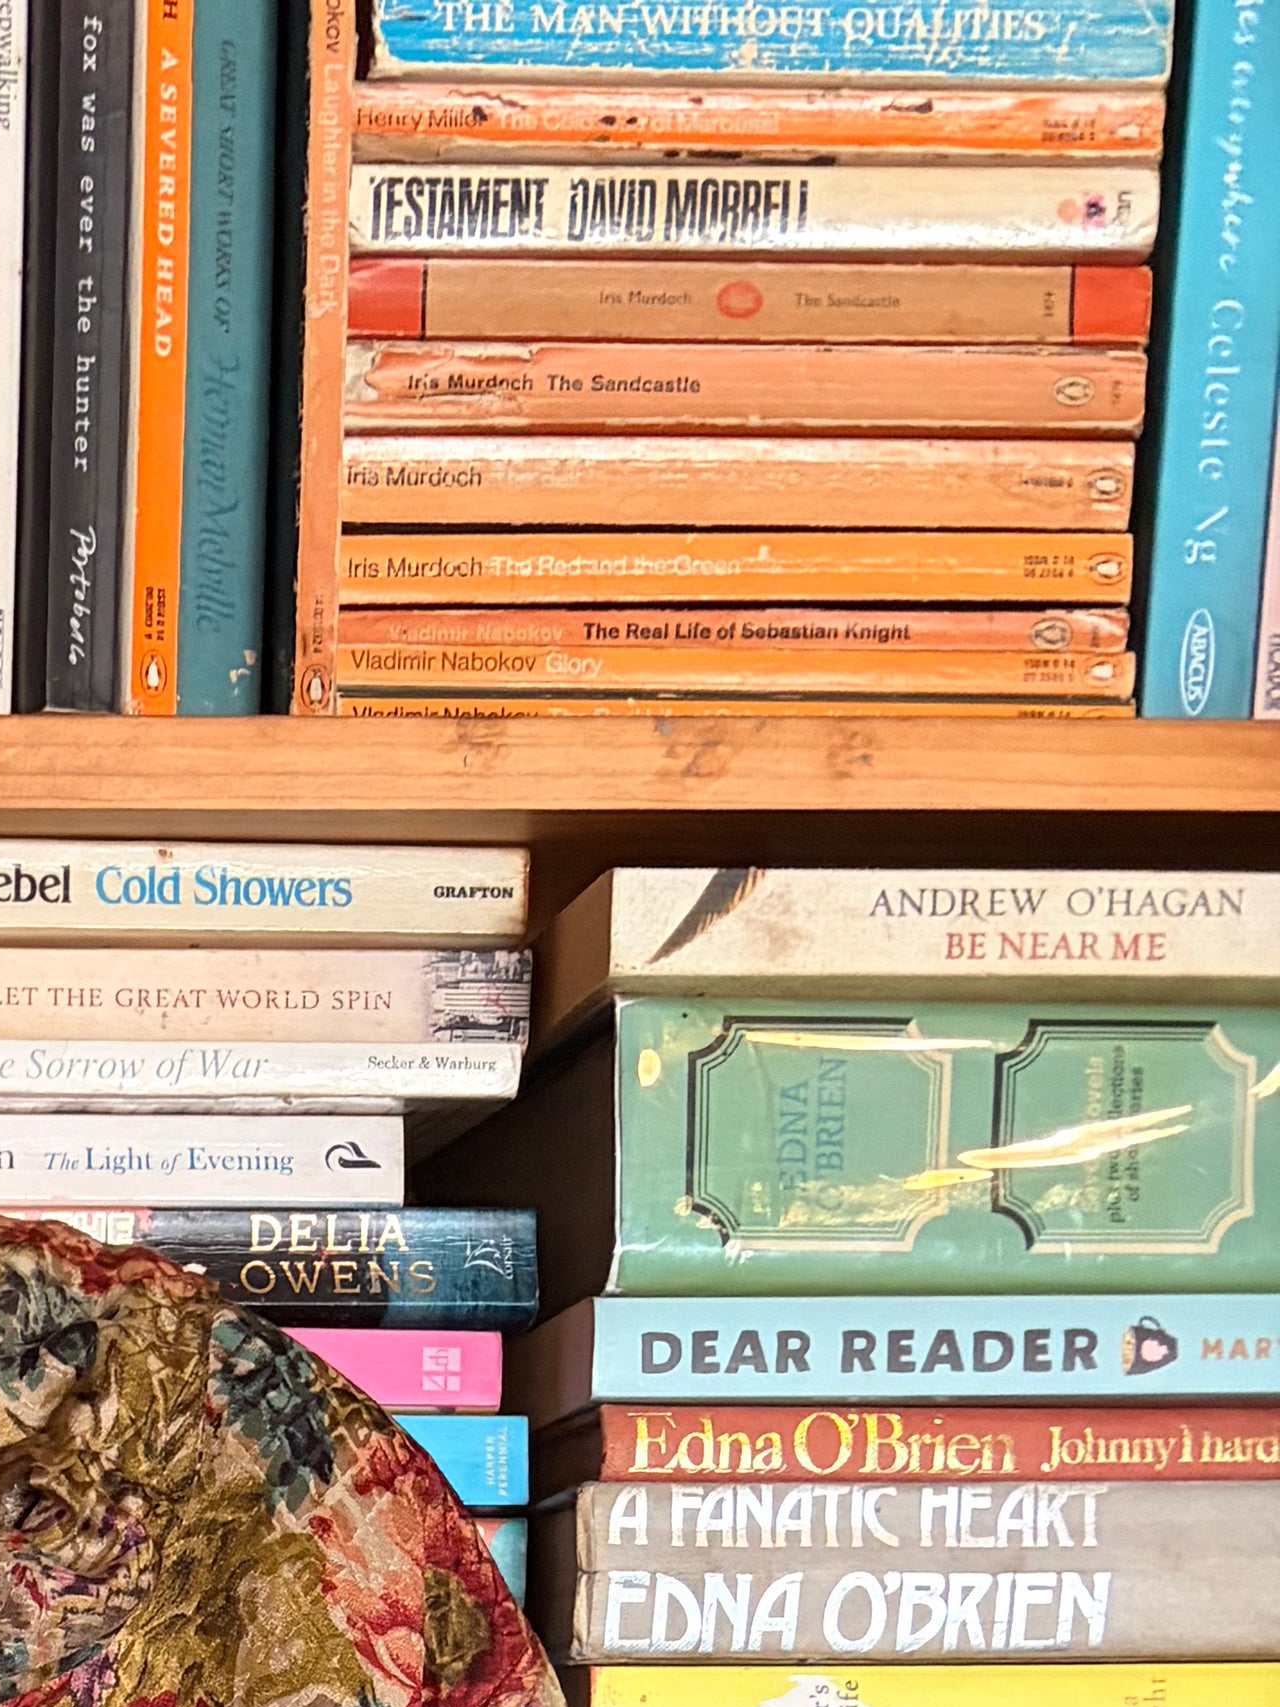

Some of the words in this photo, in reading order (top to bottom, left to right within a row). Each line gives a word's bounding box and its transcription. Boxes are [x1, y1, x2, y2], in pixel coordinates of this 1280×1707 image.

[82, 15, 102, 74] fox
[80, 92, 96, 154] was
[80, 178, 95, 252] ever
[78, 275, 95, 334] the
[75, 355, 96, 470] hunter
[583, 622, 620, 642] The
[627, 622, 671, 642] Real
[675, 622, 711, 642] Life
[716, 622, 736, 642] of
[740, 622, 840, 643] Sebastian
[845, 622, 913, 645] Knight
[95, 866, 182, 906] Cold
[192, 867, 354, 908] Showers
[432, 884, 515, 900] GRAFTON
[869, 889, 1049, 918] ANDREW
[1066, 889, 1245, 918] O'HAGAN
[944, 932, 988, 961] BE
[998, 932, 1104, 960] NEAR
[1111, 932, 1169, 960] ME
[46, 986, 106, 1009] THE
[113, 986, 212, 1011] GREAT
[215, 988, 323, 1011] WORLD
[331, 989, 395, 1012] SPIN
[248, 1214, 410, 1255] DELIA
[240, 1259, 438, 1295] OWENS
[640, 1329, 812, 1375] DEAR
[840, 1330, 1100, 1374] READER
